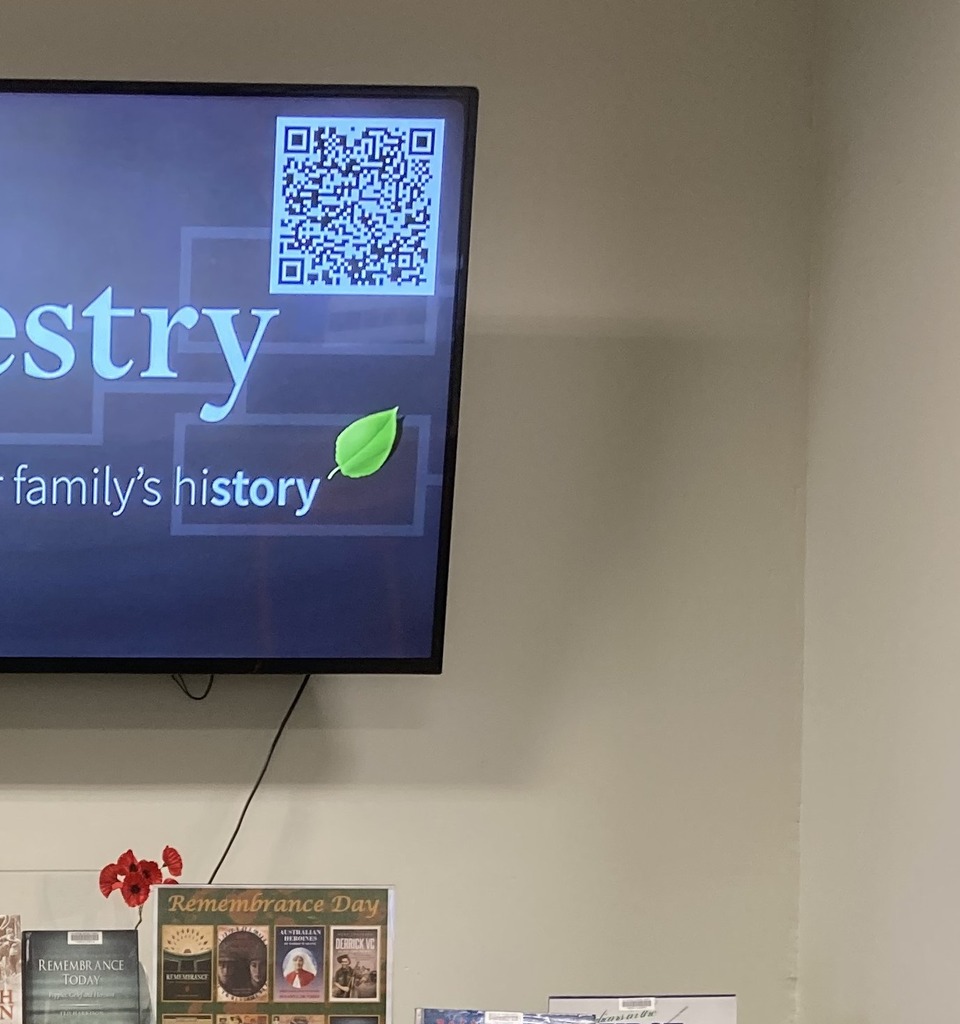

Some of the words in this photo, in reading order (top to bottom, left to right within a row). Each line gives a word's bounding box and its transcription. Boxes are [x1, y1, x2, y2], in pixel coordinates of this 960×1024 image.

[13, 464, 162, 517] family's
[174, 466, 320, 516] history
[168, 892, 324, 912] Remembrance
[332, 895, 380, 919] Day
[335, 938, 364, 950] DERRICK
[366, 937, 376, 950] VC
[38, 958, 124, 972] REMEMBRANCE
[62, 974, 100, 985] TODAY
